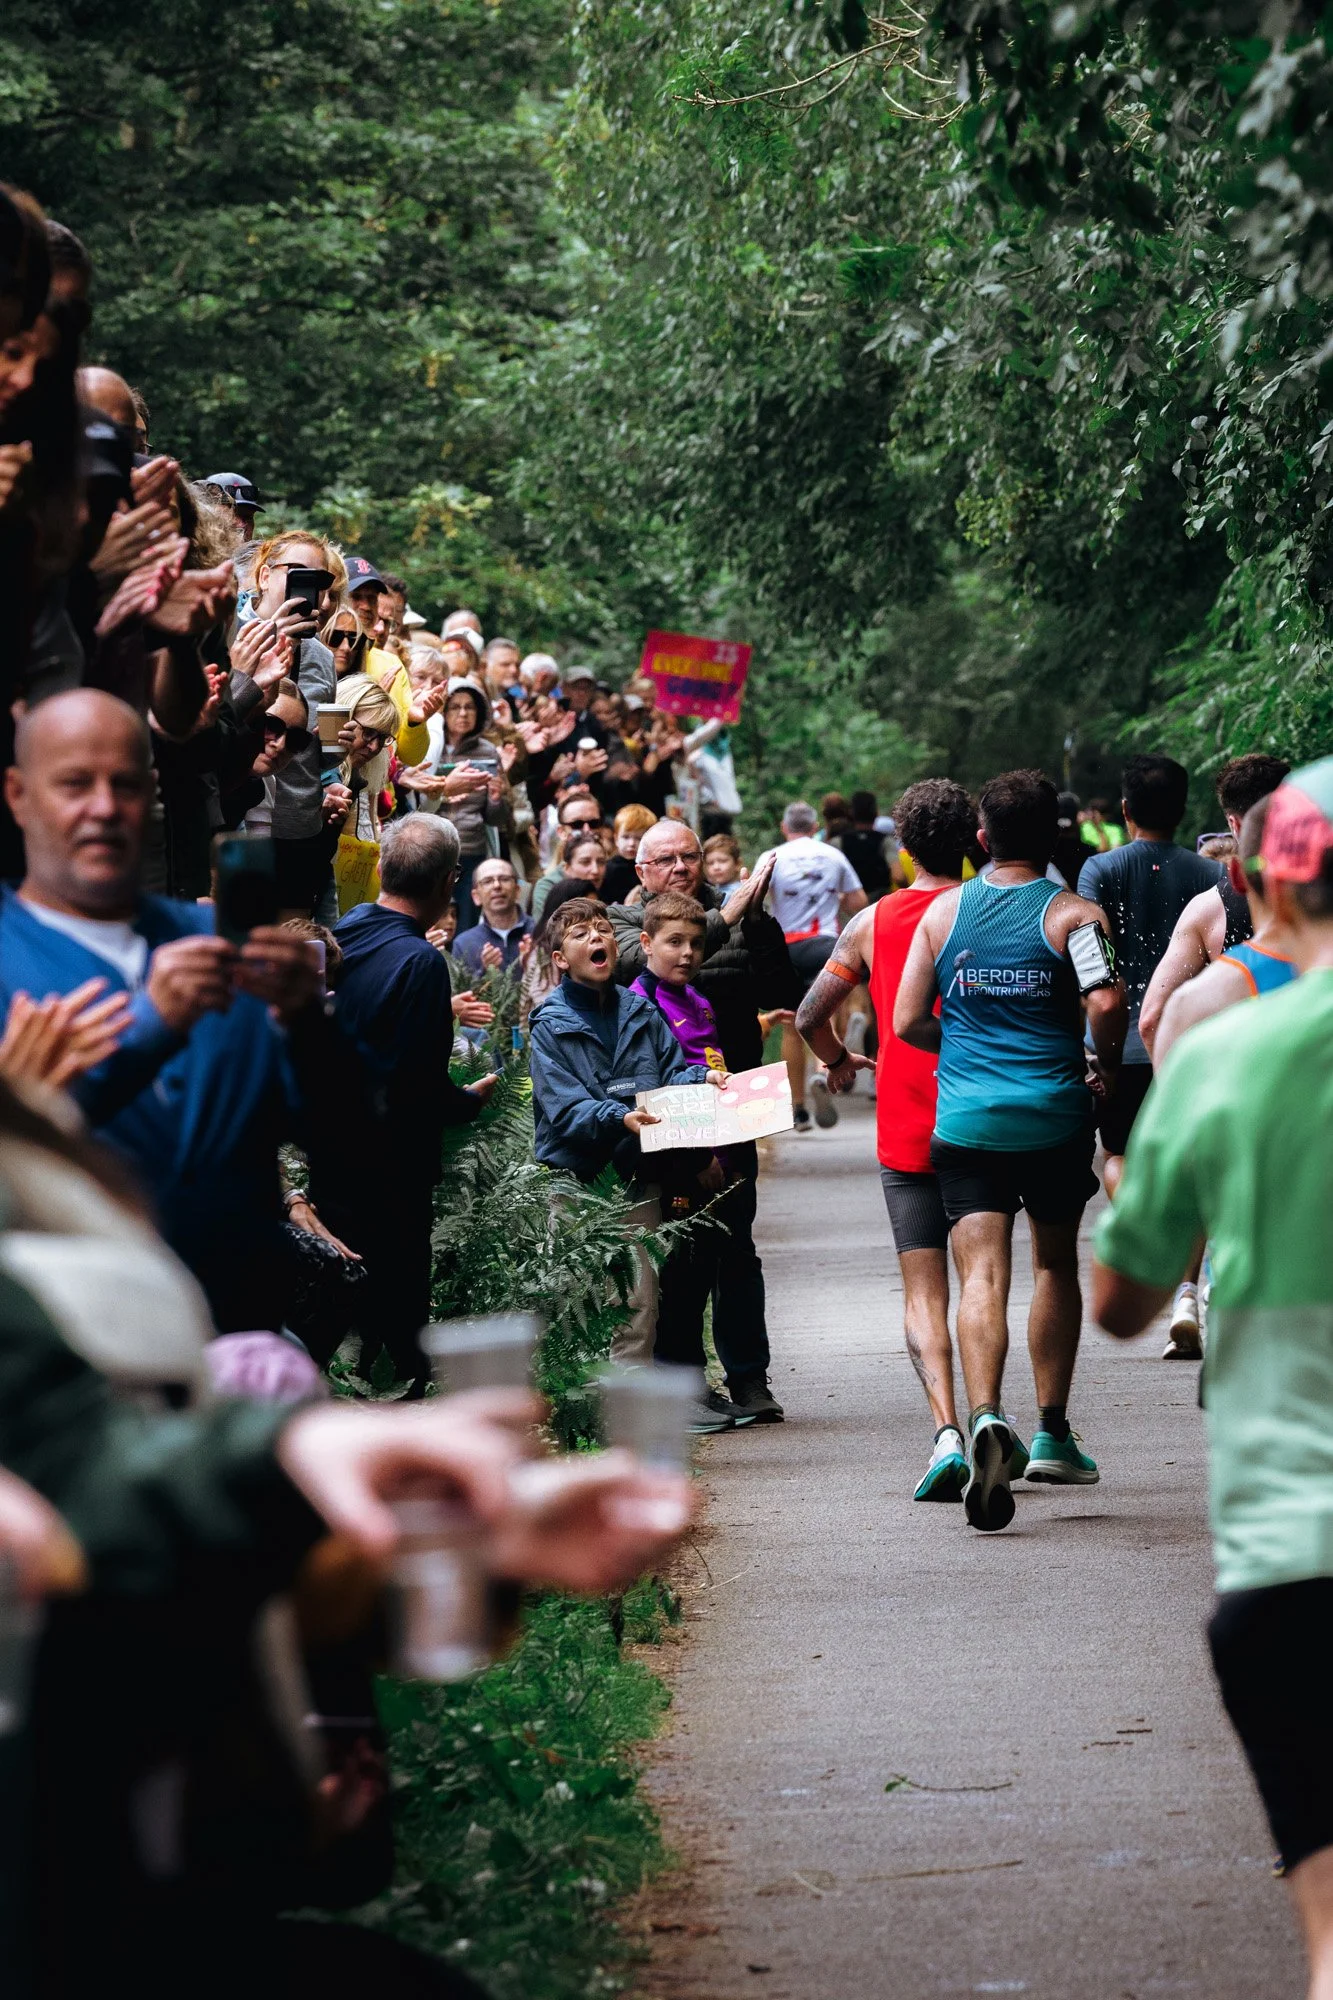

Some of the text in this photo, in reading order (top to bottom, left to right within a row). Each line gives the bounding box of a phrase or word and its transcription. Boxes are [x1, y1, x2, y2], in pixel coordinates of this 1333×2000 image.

[341, 860, 375, 887] GREAT
[946, 968, 1052, 998] ABERDEEN
[967, 986, 1051, 997] FRONTRUNNERS
[650, 1086, 714, 1103] TAP
[670, 1113, 714, 1128] TO
[650, 1123, 732, 1144] POWER
